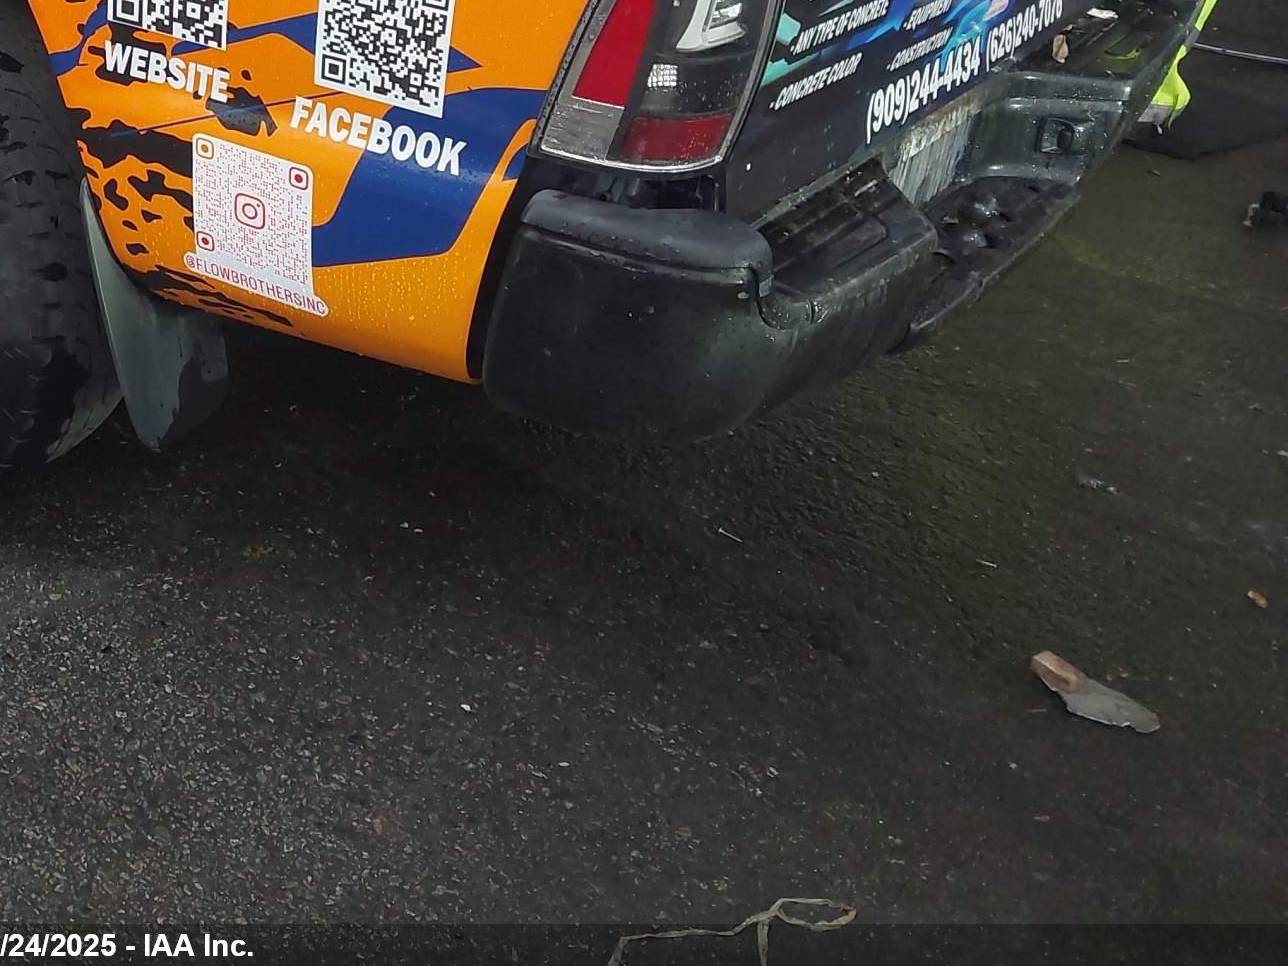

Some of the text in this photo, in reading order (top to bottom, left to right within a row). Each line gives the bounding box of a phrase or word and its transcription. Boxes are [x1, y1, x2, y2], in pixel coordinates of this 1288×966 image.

[793, 27, 817, 56] ANY
[814, 18, 837, 46] TYPE
[834, 13, 848, 36] OF
[889, 26, 954, 71] CONSTRUCTION
[103, 40, 232, 103] WEBSITE
[774, 51, 863, 111] CONCRETE COLOR
[866, 32, 981, 144] (909)244-4434
[289, 94, 467, 177] FACEBOOK
[185, 254, 326, 315] @FLOWBROTHERSINC
